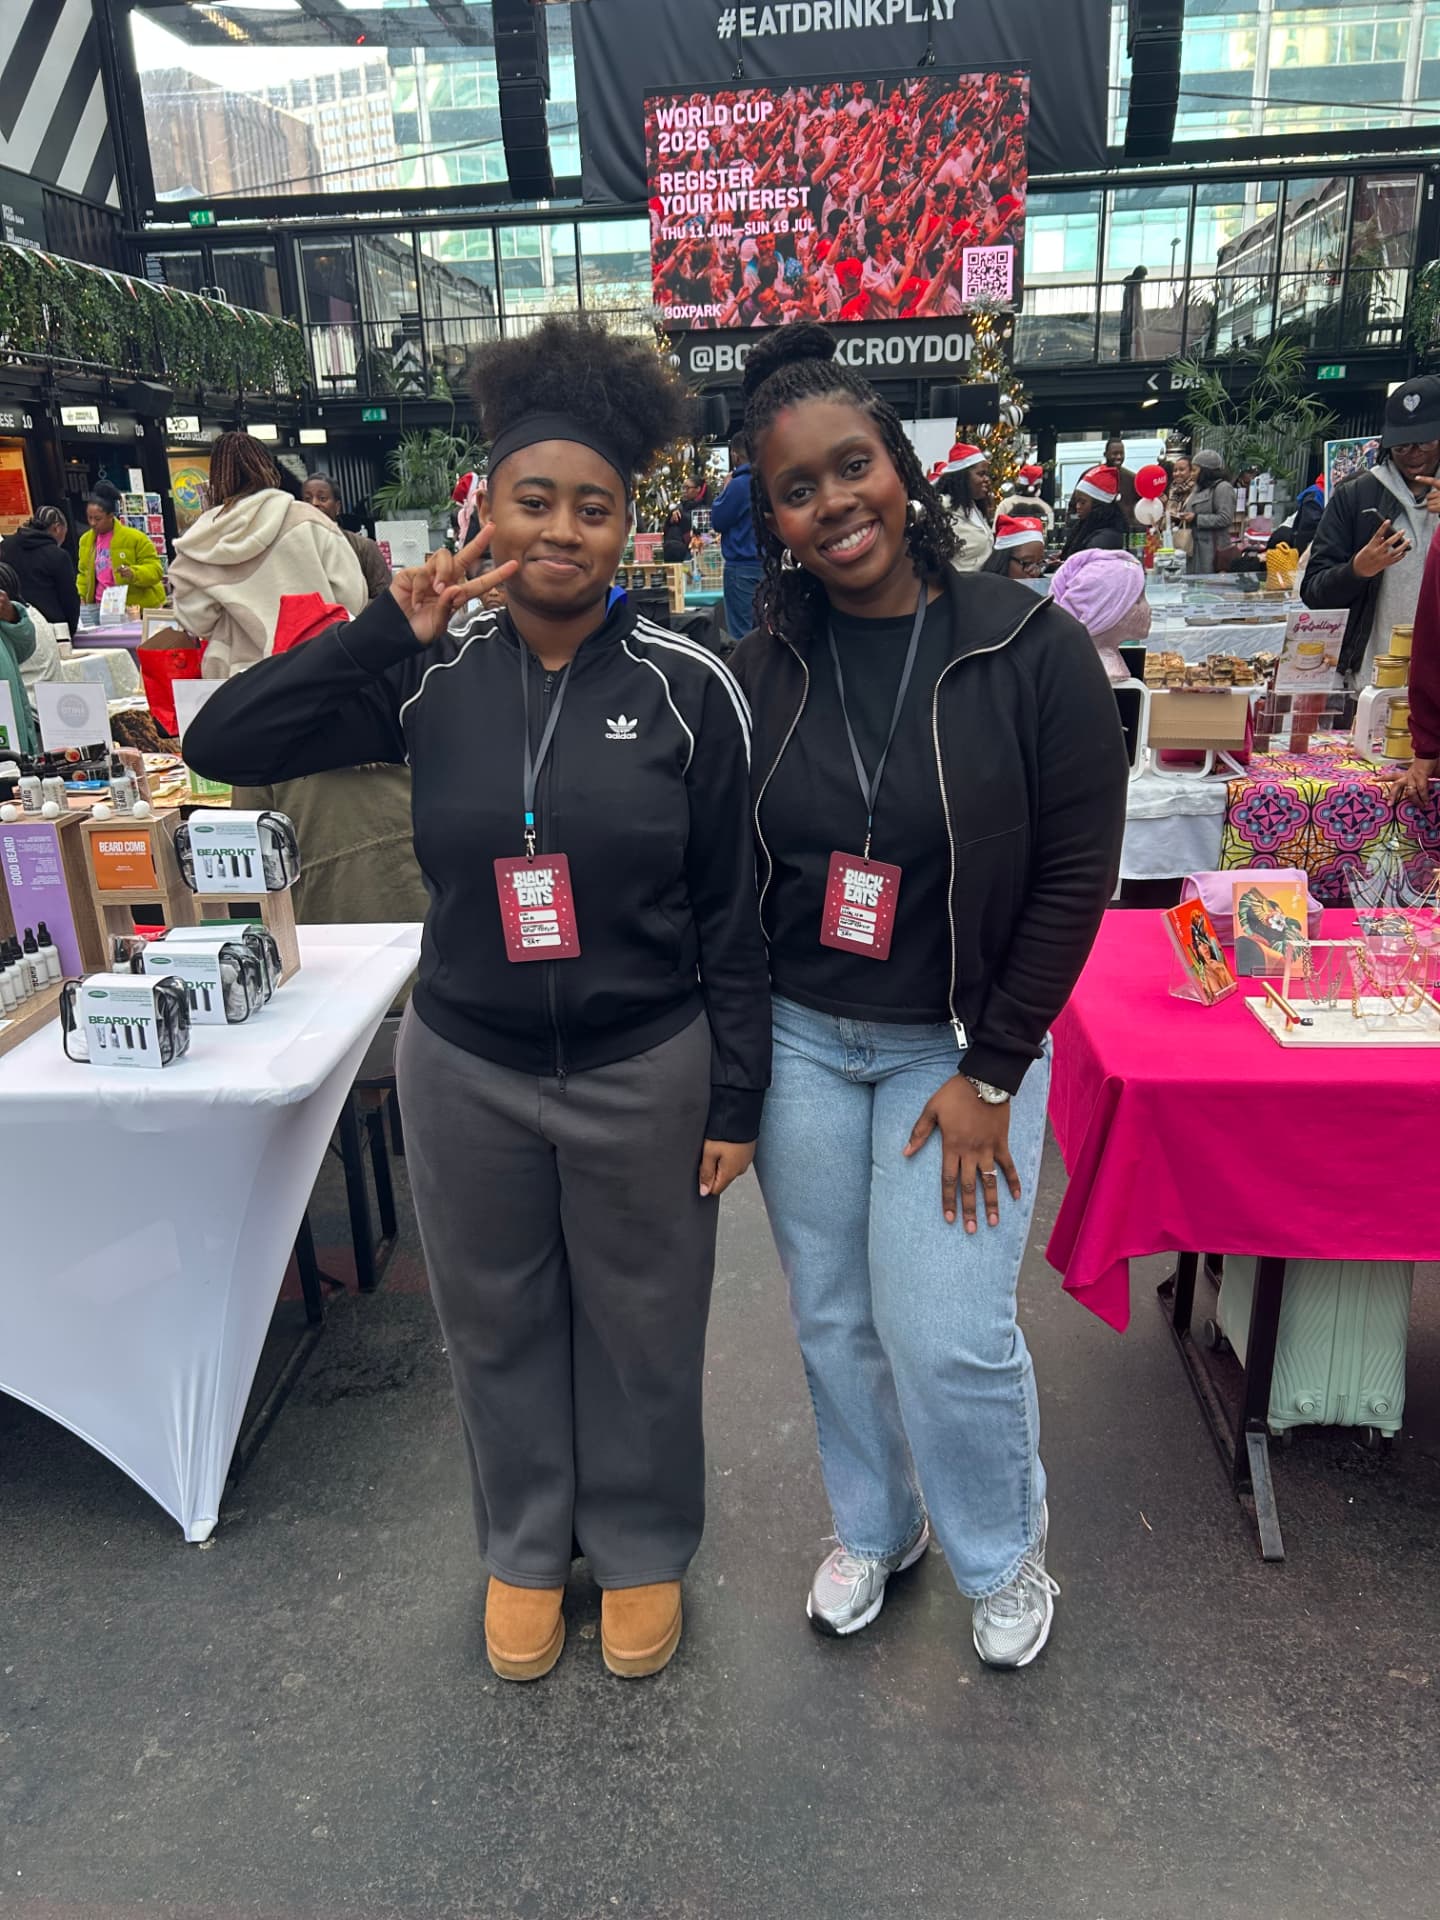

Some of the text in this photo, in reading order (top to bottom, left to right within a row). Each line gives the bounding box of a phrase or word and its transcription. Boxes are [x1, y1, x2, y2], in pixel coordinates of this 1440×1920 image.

[717, 0, 957, 39] #EATDRINKPLAY
[656, 101, 774, 129] WORLD CUP
[658, 130, 710, 153] 2026
[659, 168, 755, 193] REGISTER
[659, 187, 811, 216] YOUR INTEREST
[661, 226, 686, 240] THU
[690, 225, 705, 238] 11
[774, 220, 790, 233] 19
[791, 218, 816, 232] JUL
[664, 303, 722, 320] BOXPARK
[22, 414, 33, 429] 10
[605, 732, 638, 740] adidas
[99, 841, 146, 853] BEARD COMB
[197, 848, 256, 856] BEARD KIT
[3, 836, 23, 886] GOOD BEARD
[512, 869, 555, 889] BLACK
[843, 869, 884, 892] BLACK
[517, 886, 554, 907] EATS
[844, 884, 879, 908] EATS
[195, 981, 217, 990] KIT
[88, 1015, 151, 1026] BEARD KIT
